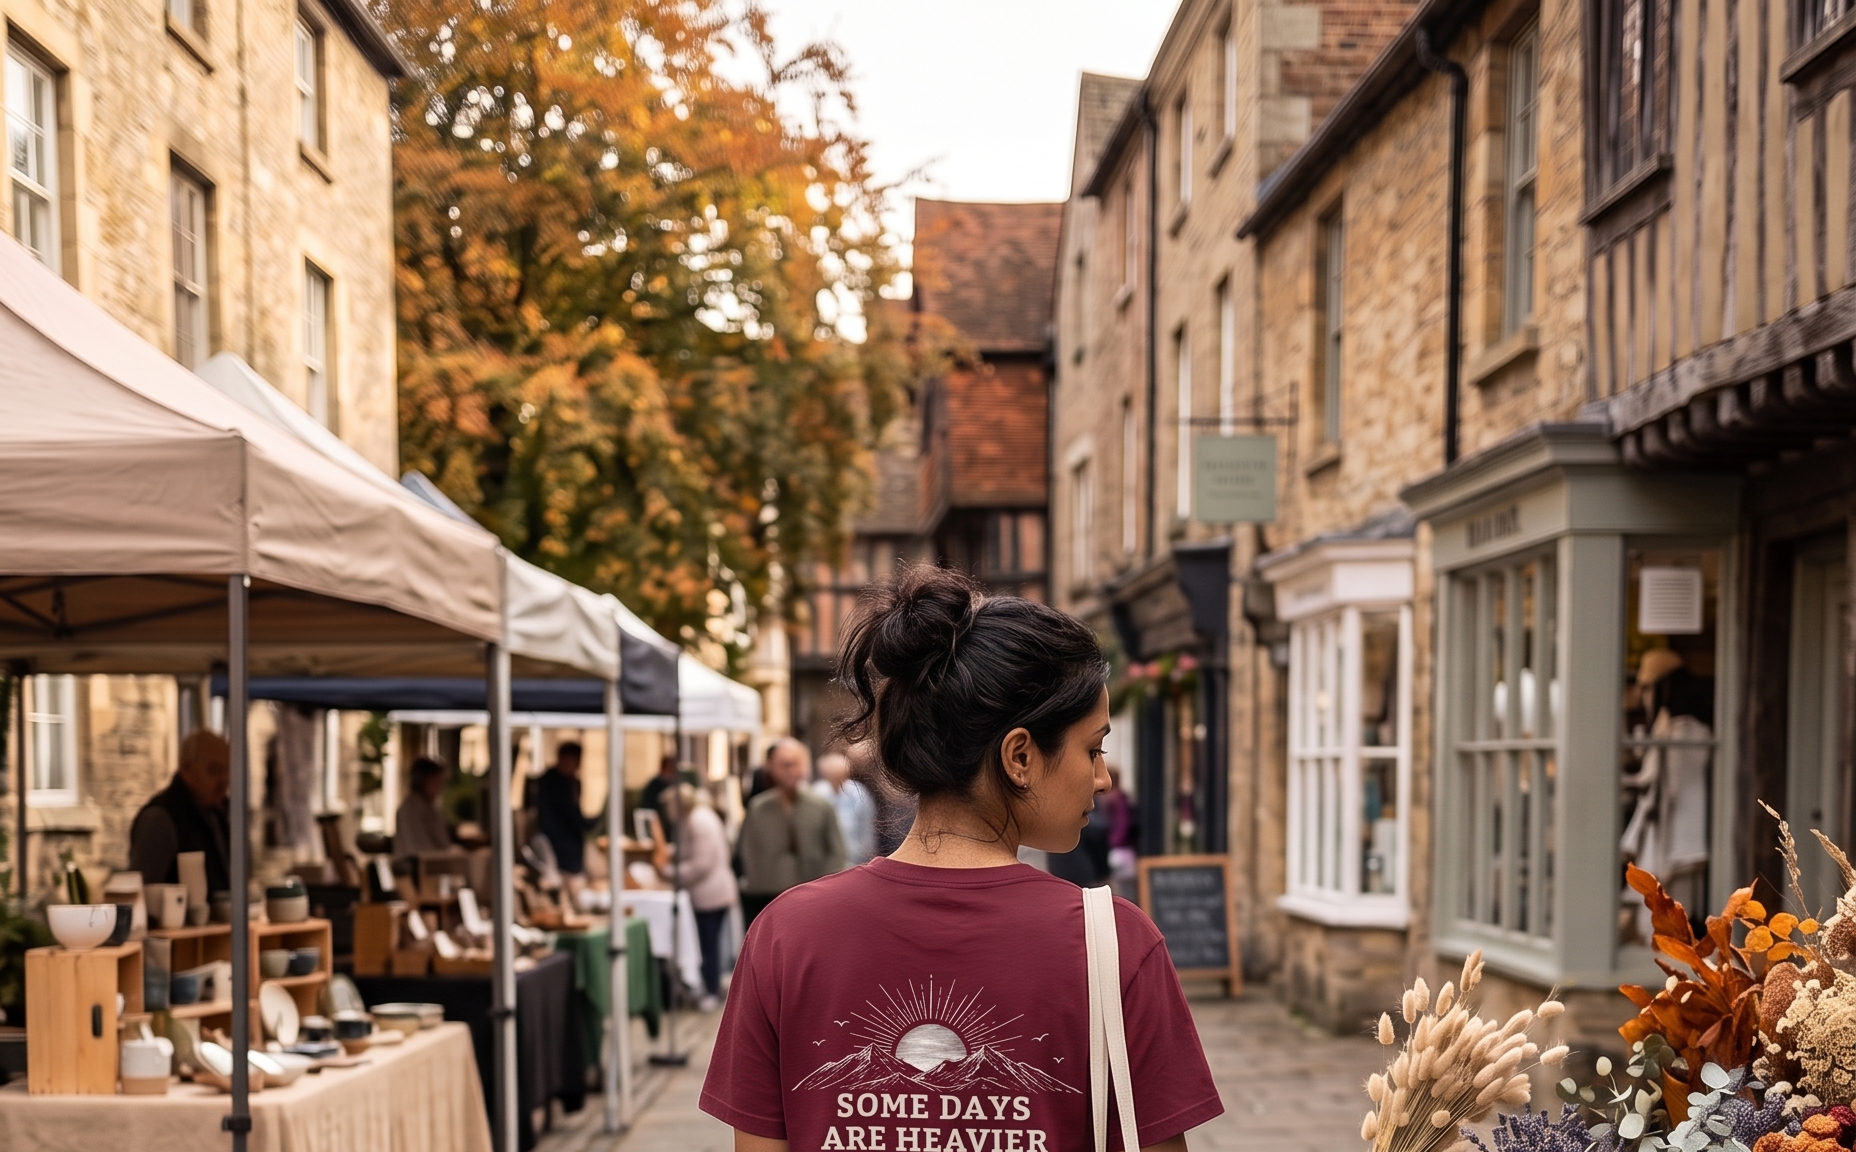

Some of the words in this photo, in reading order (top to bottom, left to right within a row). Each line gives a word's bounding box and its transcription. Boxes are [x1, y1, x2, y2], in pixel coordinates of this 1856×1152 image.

[838, 1093, 928, 1118] SOME
[940, 1095, 1030, 1120] DAYS
[821, 1126, 885, 1150] ARE
